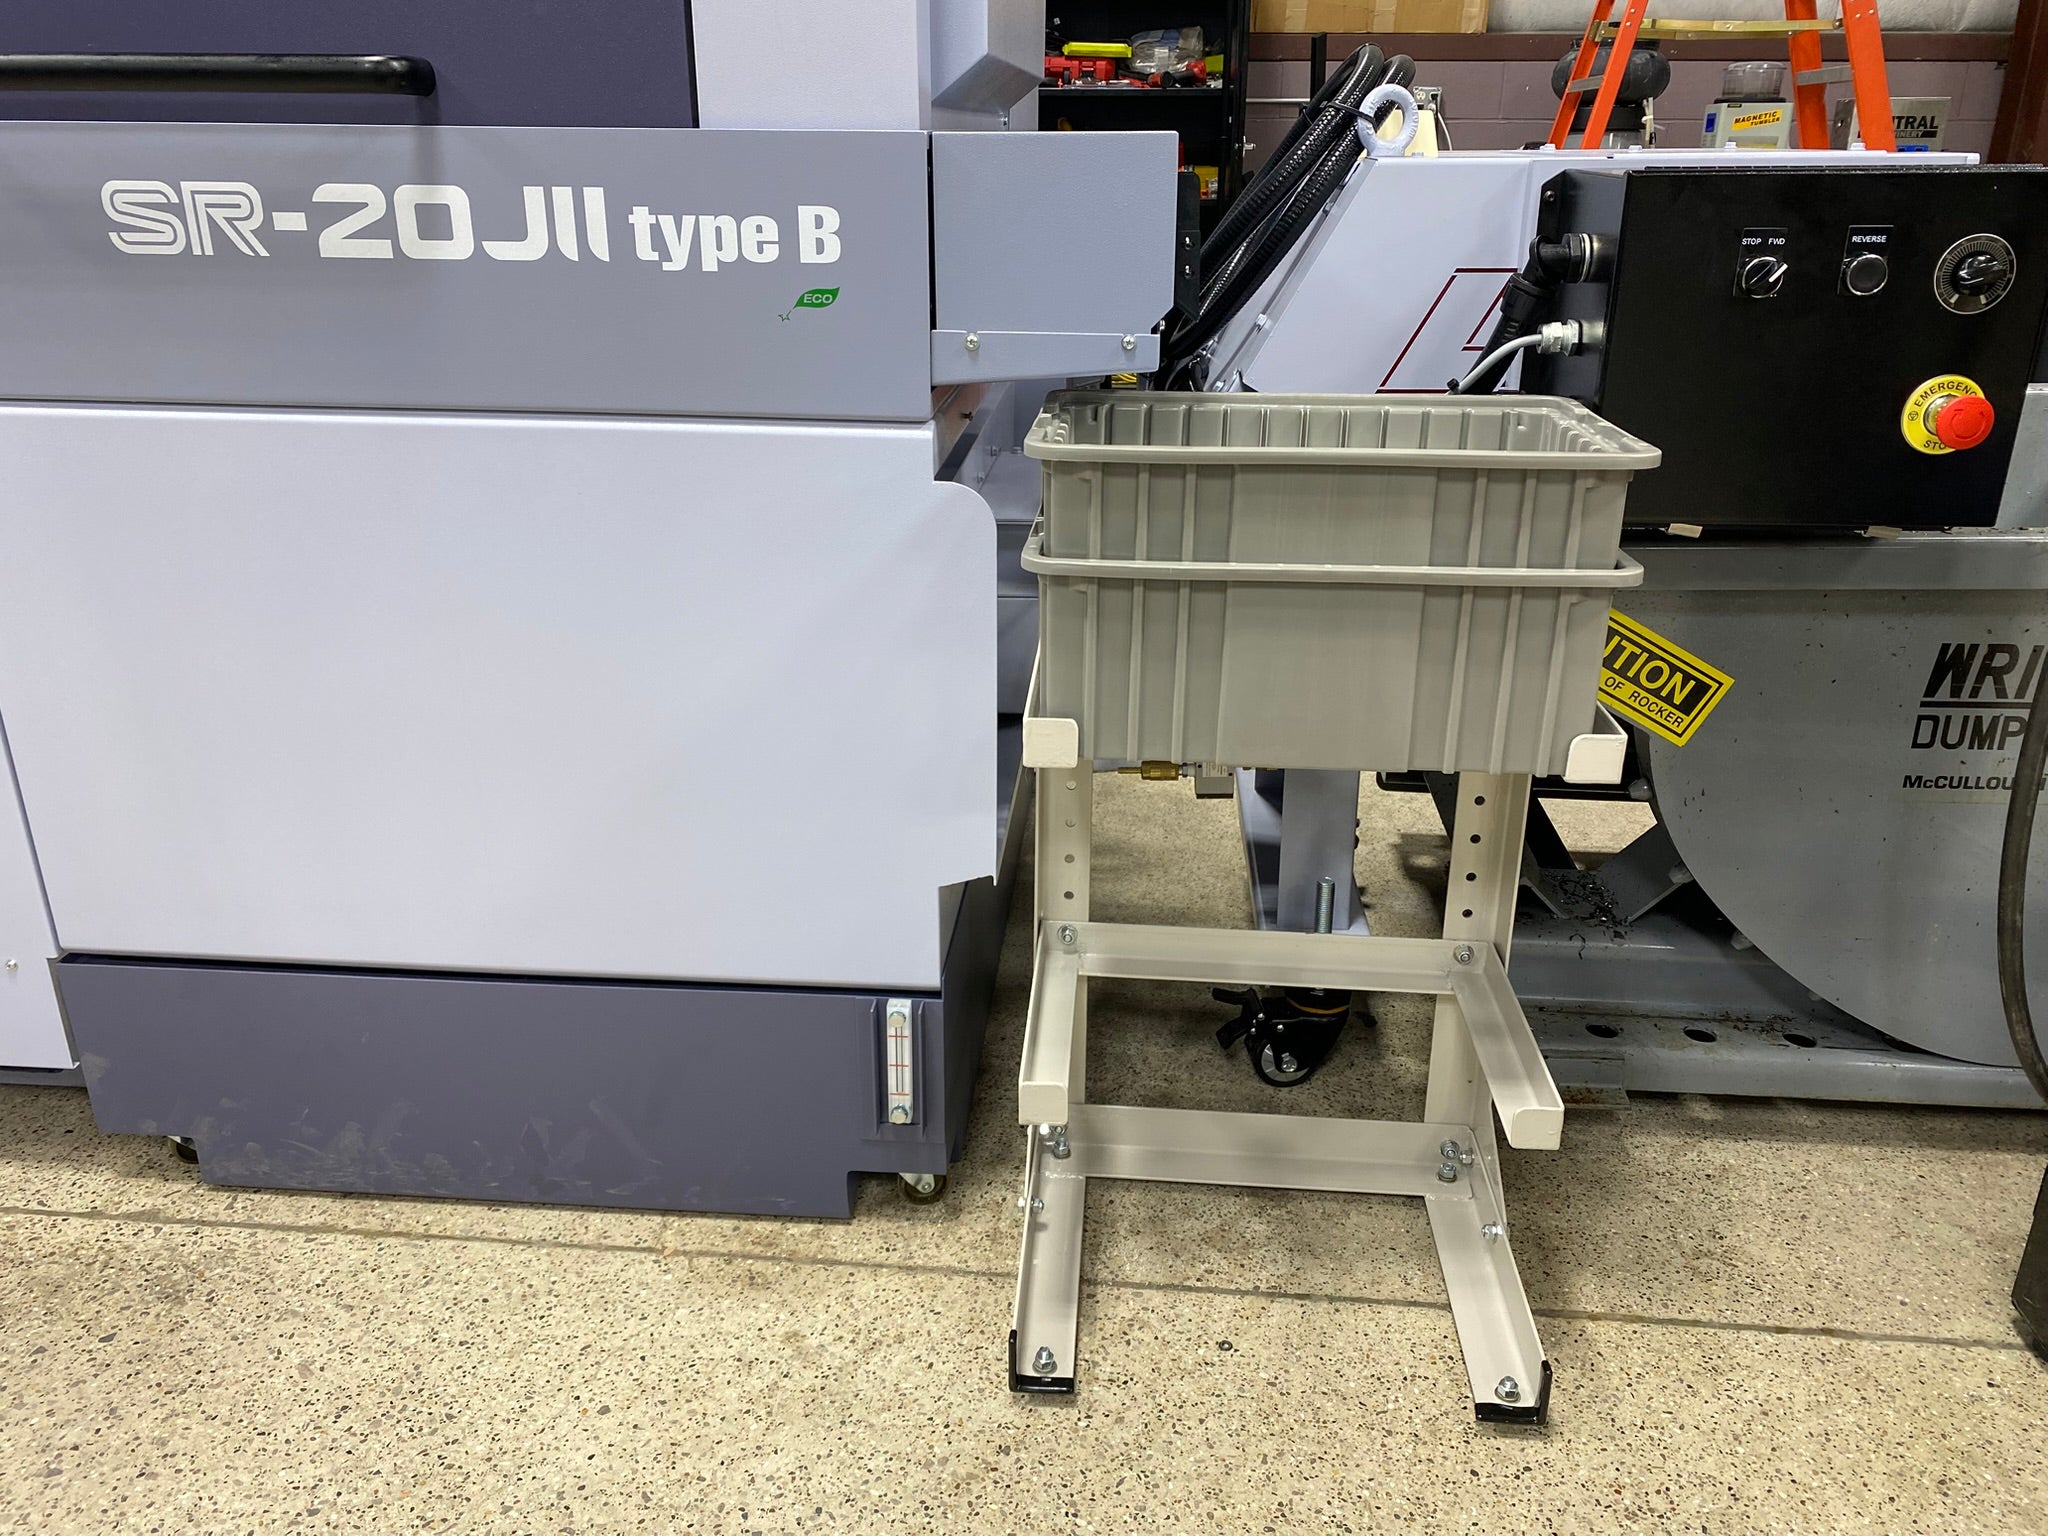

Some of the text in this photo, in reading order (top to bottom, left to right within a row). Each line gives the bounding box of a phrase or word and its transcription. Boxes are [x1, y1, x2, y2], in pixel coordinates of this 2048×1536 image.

[1734, 111, 1778, 124] MAGNETIC
[1892, 115, 1939, 130] TRAL
[1894, 130, 1925, 138] INERY
[628, 206, 780, 272] type
[797, 205, 842, 264] B
[1741, 237, 1786, 246] STOP FWD
[1852, 235, 1887, 244] REVERSE
[803, 293, 833, 305] ECO
[1914, 380, 1978, 408] EMERGENC
[1923, 439, 1946, 451] STO
[1922, 642, 2046, 700] WRI
[1604, 676, 1685, 728] OF ROCKER
[1902, 774, 2047, 791] McCULLOU
